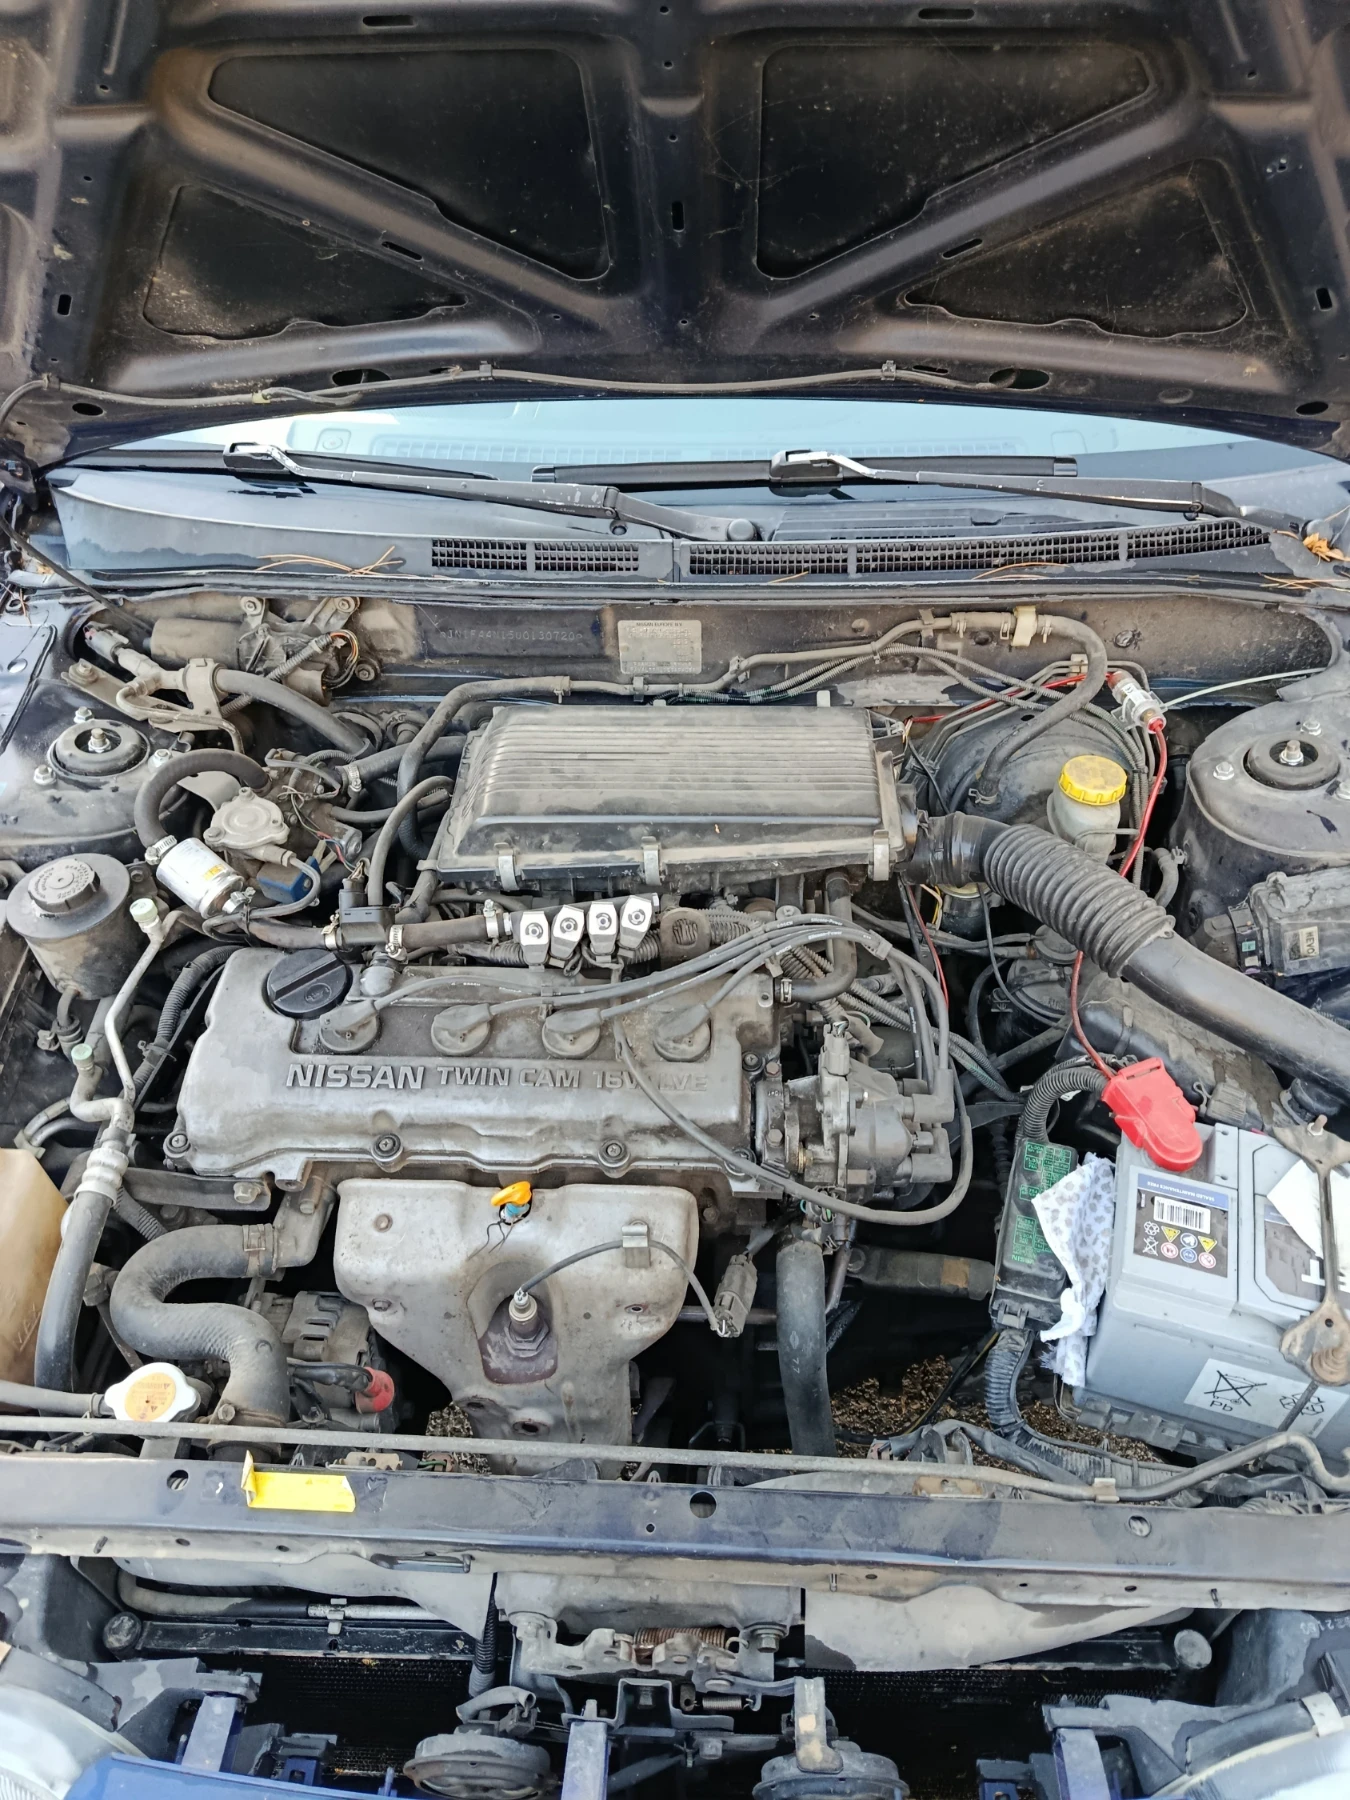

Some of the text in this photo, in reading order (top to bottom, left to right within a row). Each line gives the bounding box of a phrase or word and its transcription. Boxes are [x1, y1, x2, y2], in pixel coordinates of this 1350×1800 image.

[285, 1062, 708, 1092] NISSAN TWIN CAM 16VLVE
[1160, 1184, 1196, 1197] MAINTENANCE
[1196, 1193, 1215, 1202] SEALED
[1210, 1400, 1233, 1412] Pb
